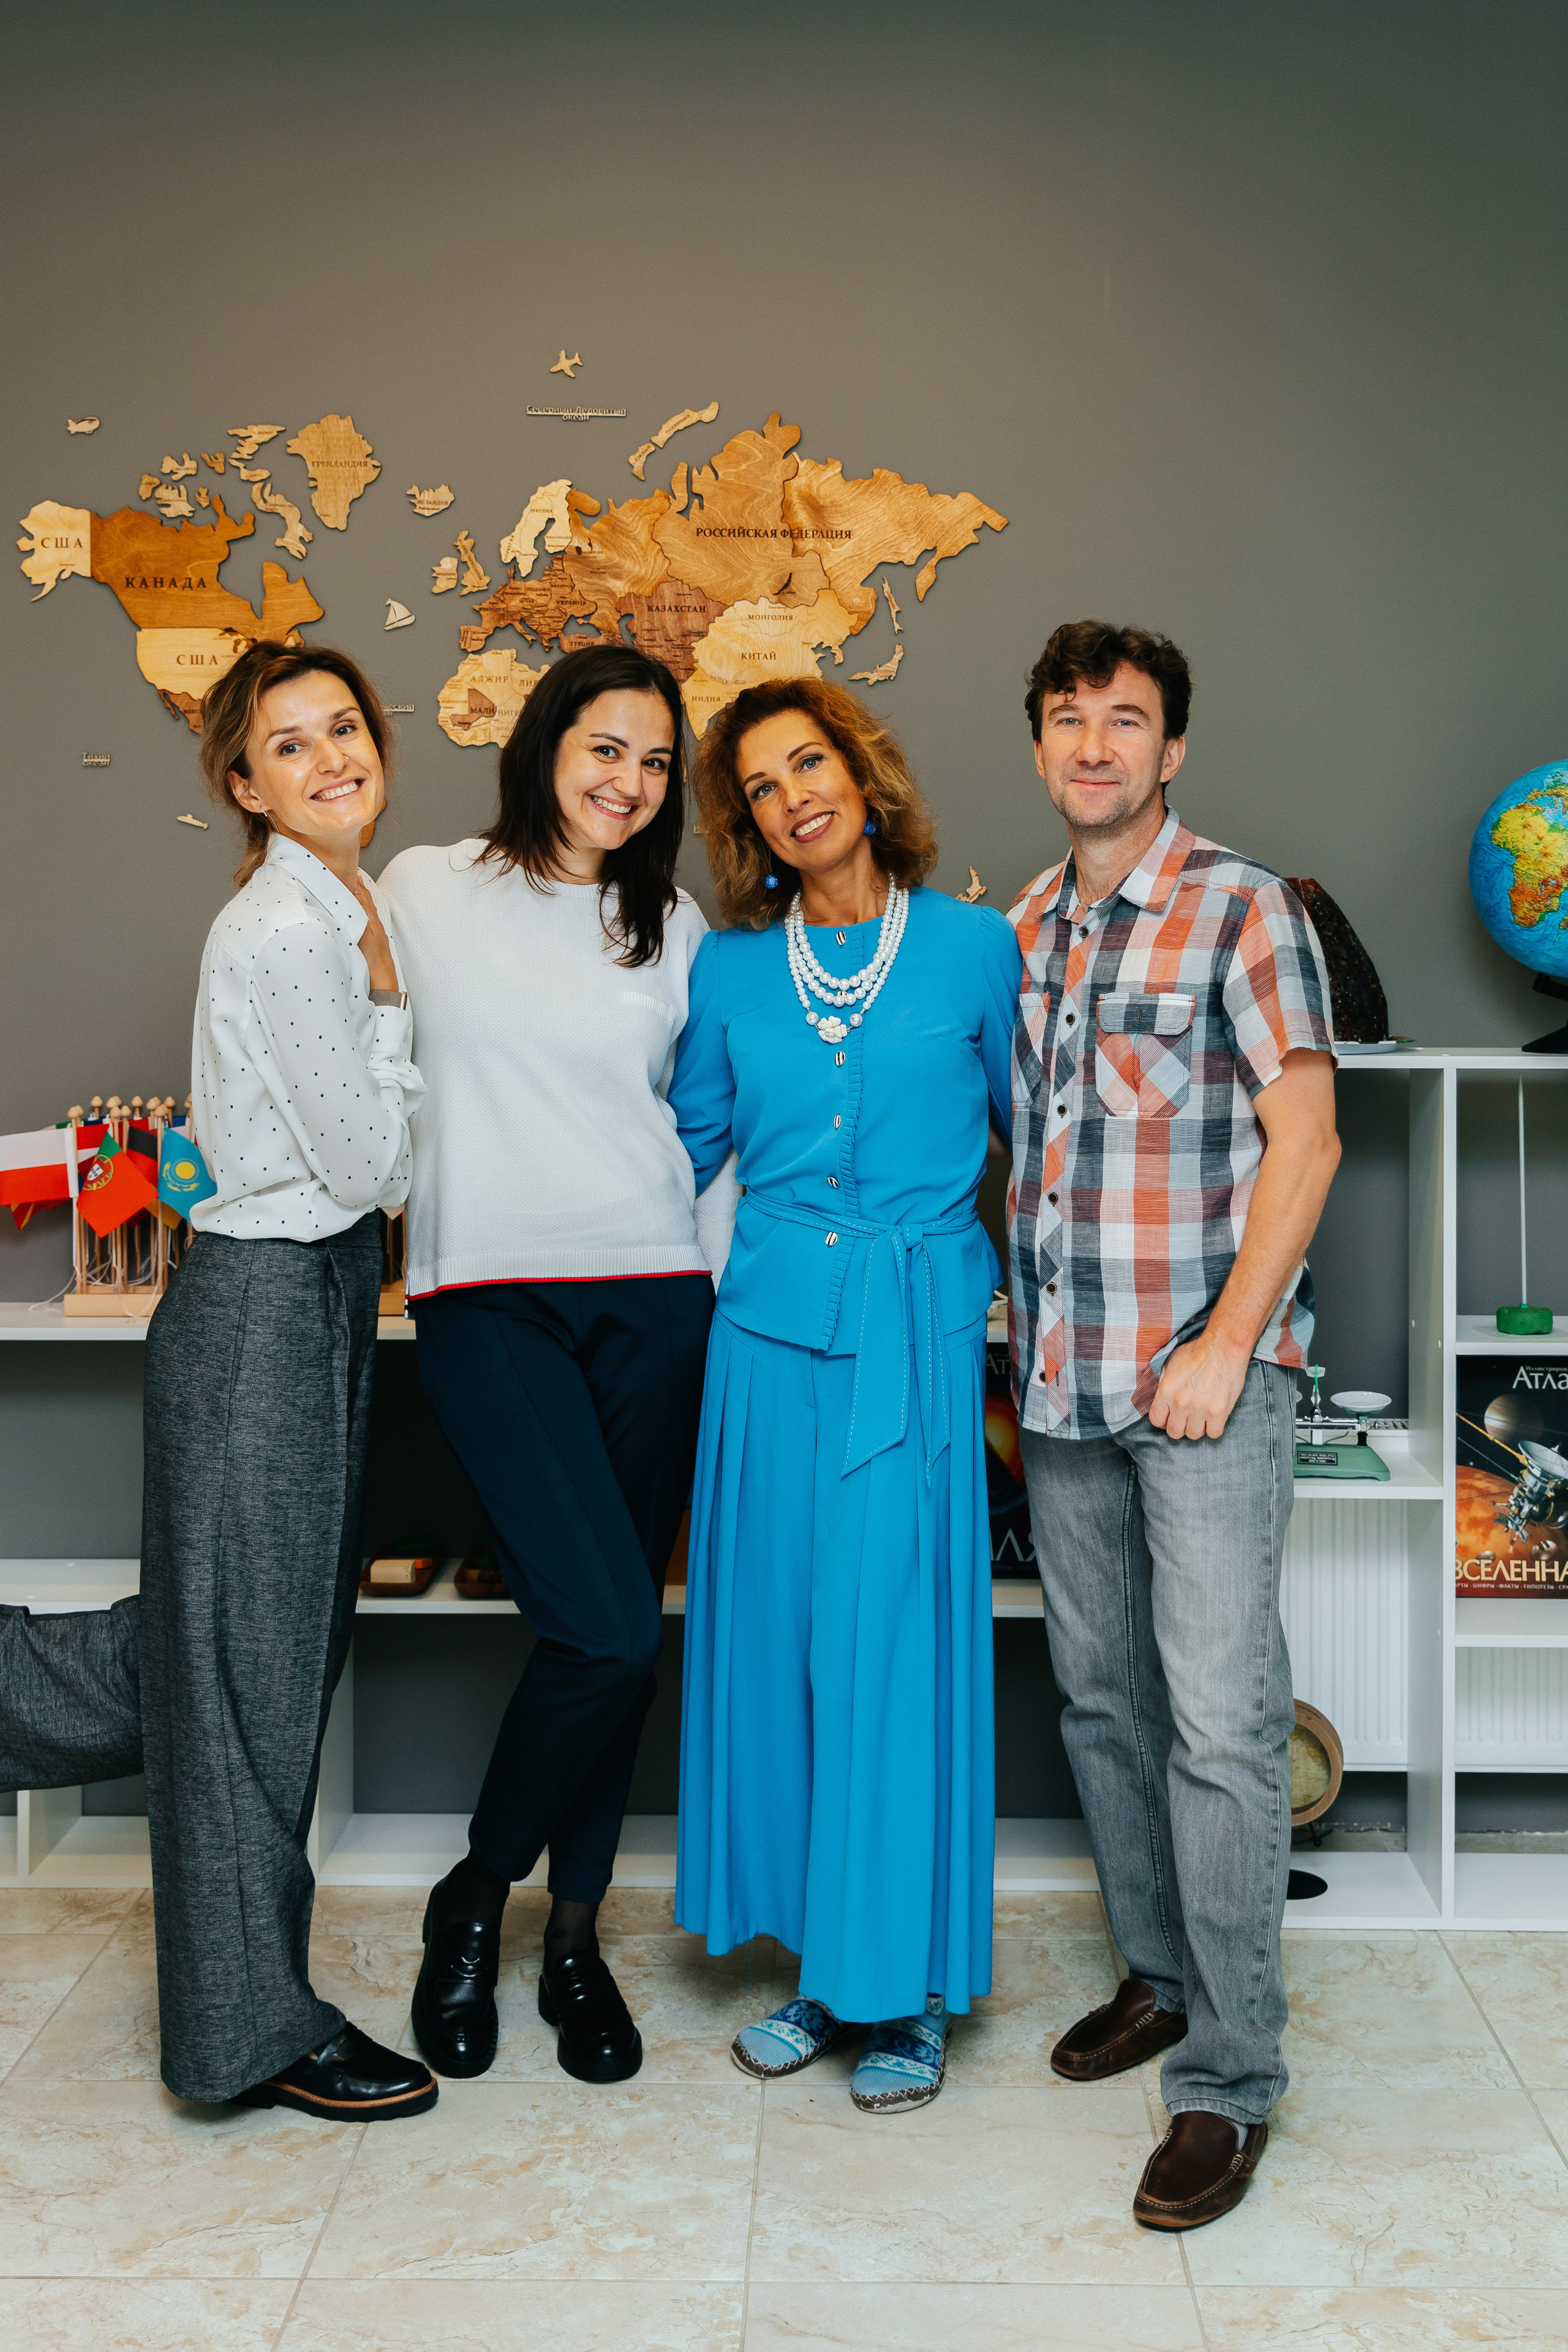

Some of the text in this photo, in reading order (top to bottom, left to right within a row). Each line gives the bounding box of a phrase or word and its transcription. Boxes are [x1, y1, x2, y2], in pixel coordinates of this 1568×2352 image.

[526, 405, 627, 417] Северный Ледовитый
[695, 526, 852, 541] РОССИЙСКАЯ ФЕДЕРАЦИЯ
[40, 537, 83, 549] США
[124, 576, 208, 590] КАНАДА
[647, 605, 706, 613] КАЗАХСТАН
[176, 654, 219, 665] США
[741, 651, 777, 660] КИТАЙ
